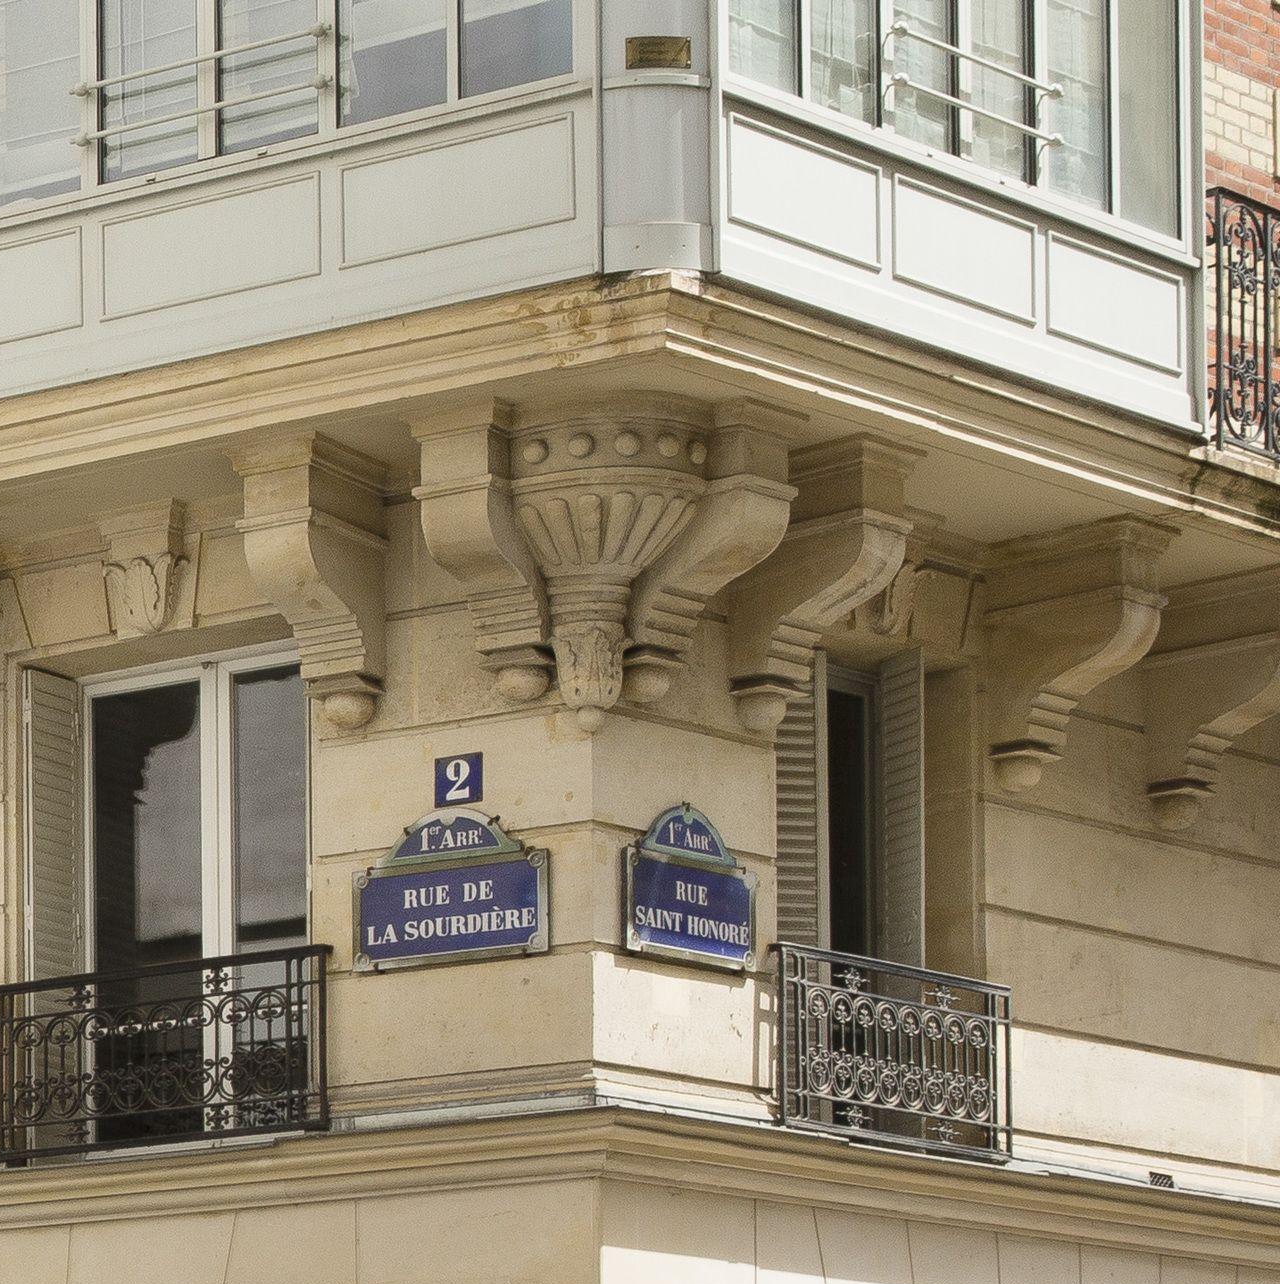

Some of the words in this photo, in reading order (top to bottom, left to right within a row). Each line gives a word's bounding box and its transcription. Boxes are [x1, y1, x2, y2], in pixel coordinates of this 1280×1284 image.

[445, 759, 470, 801] 2
[403, 884, 450, 909] RUE
[463, 880, 494, 902] DE
[676, 881, 708, 906] RUE
[366, 923, 398, 946] LA
[404, 906, 536, 941] SOURDIÈRE
[635, 906, 683, 932] SAINT
[687, 915, 750, 946] HONORÉ
